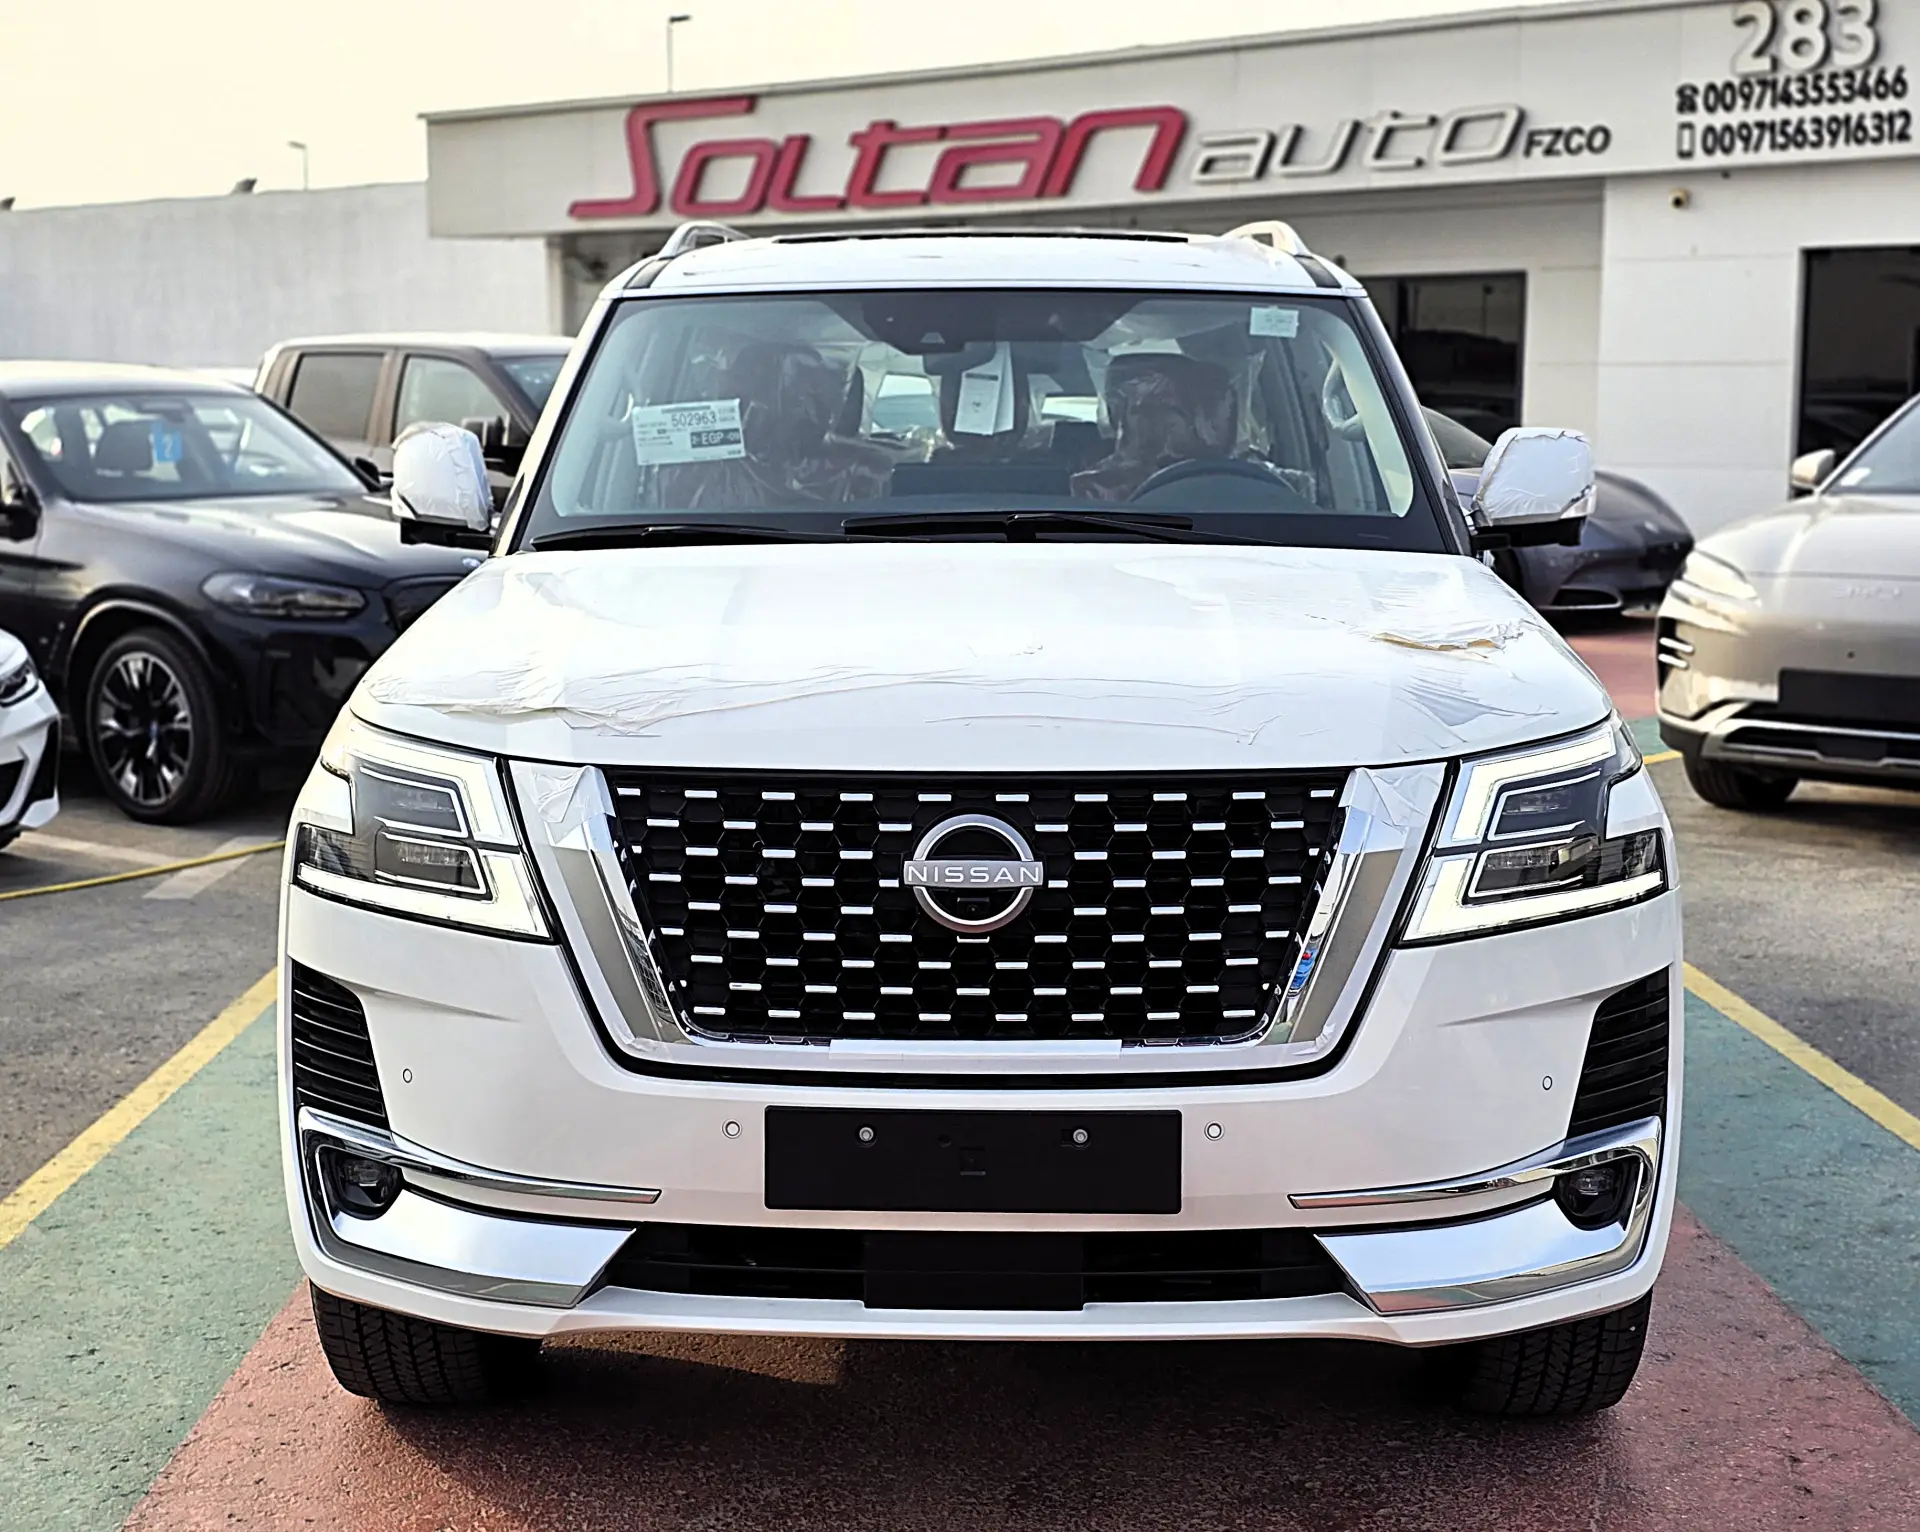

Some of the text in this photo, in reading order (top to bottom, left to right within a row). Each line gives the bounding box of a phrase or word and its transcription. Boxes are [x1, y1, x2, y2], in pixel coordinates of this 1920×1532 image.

[1734, 0, 1880, 77] 283
[1703, 66, 1908, 114] 0097143553466
[1191, 104, 1526, 184] auto
[1523, 125, 1612, 158] FZCO
[1702, 110, 1911, 155] 00971563916312
[671, 411, 717, 427] 502963
[908, 866, 1039, 882] NISSAN
